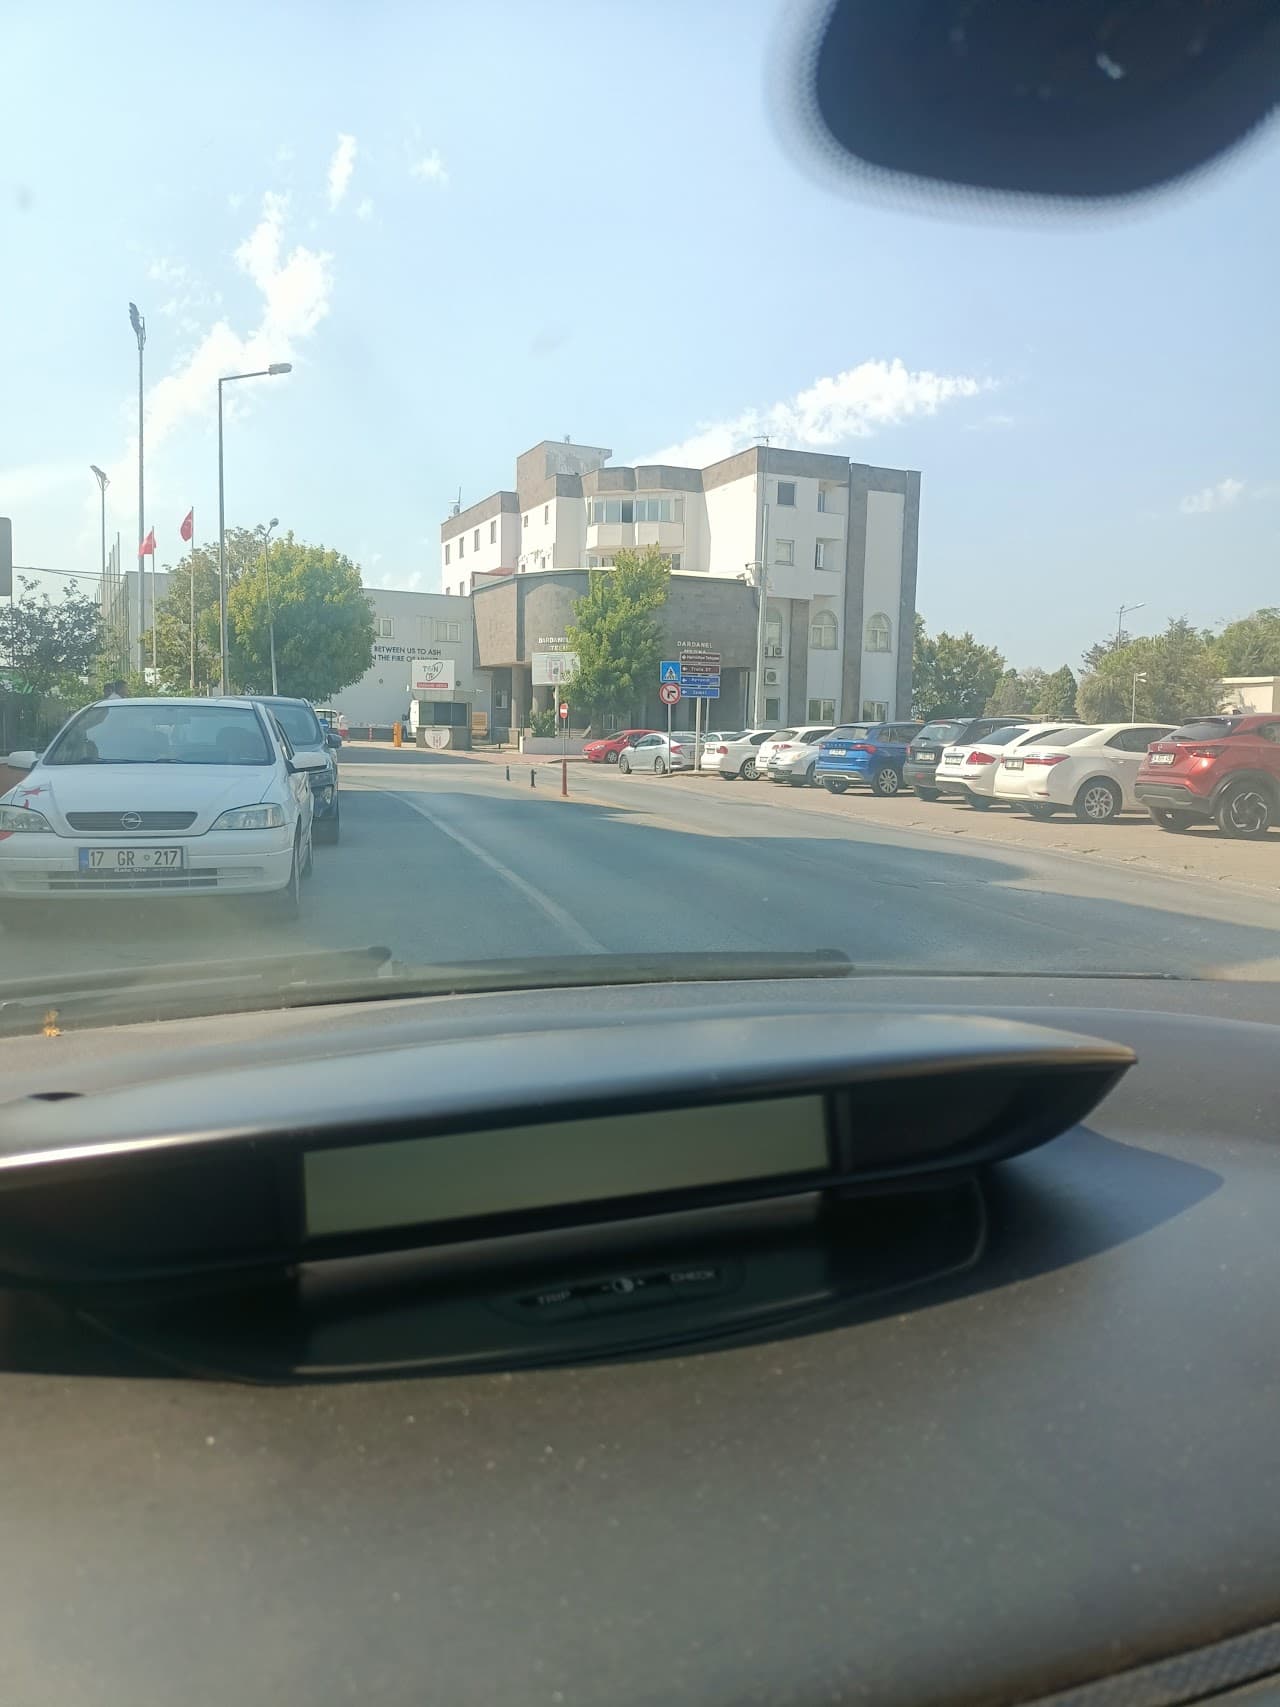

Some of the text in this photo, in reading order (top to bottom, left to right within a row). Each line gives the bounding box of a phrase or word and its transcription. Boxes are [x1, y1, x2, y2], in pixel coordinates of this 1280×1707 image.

[374, 645, 406, 654] BETWEEN
[90, 850, 178, 867] 17 GR 217
[670, 1270, 715, 1282] CHECK
[537, 1291, 572, 1304] TRIP
